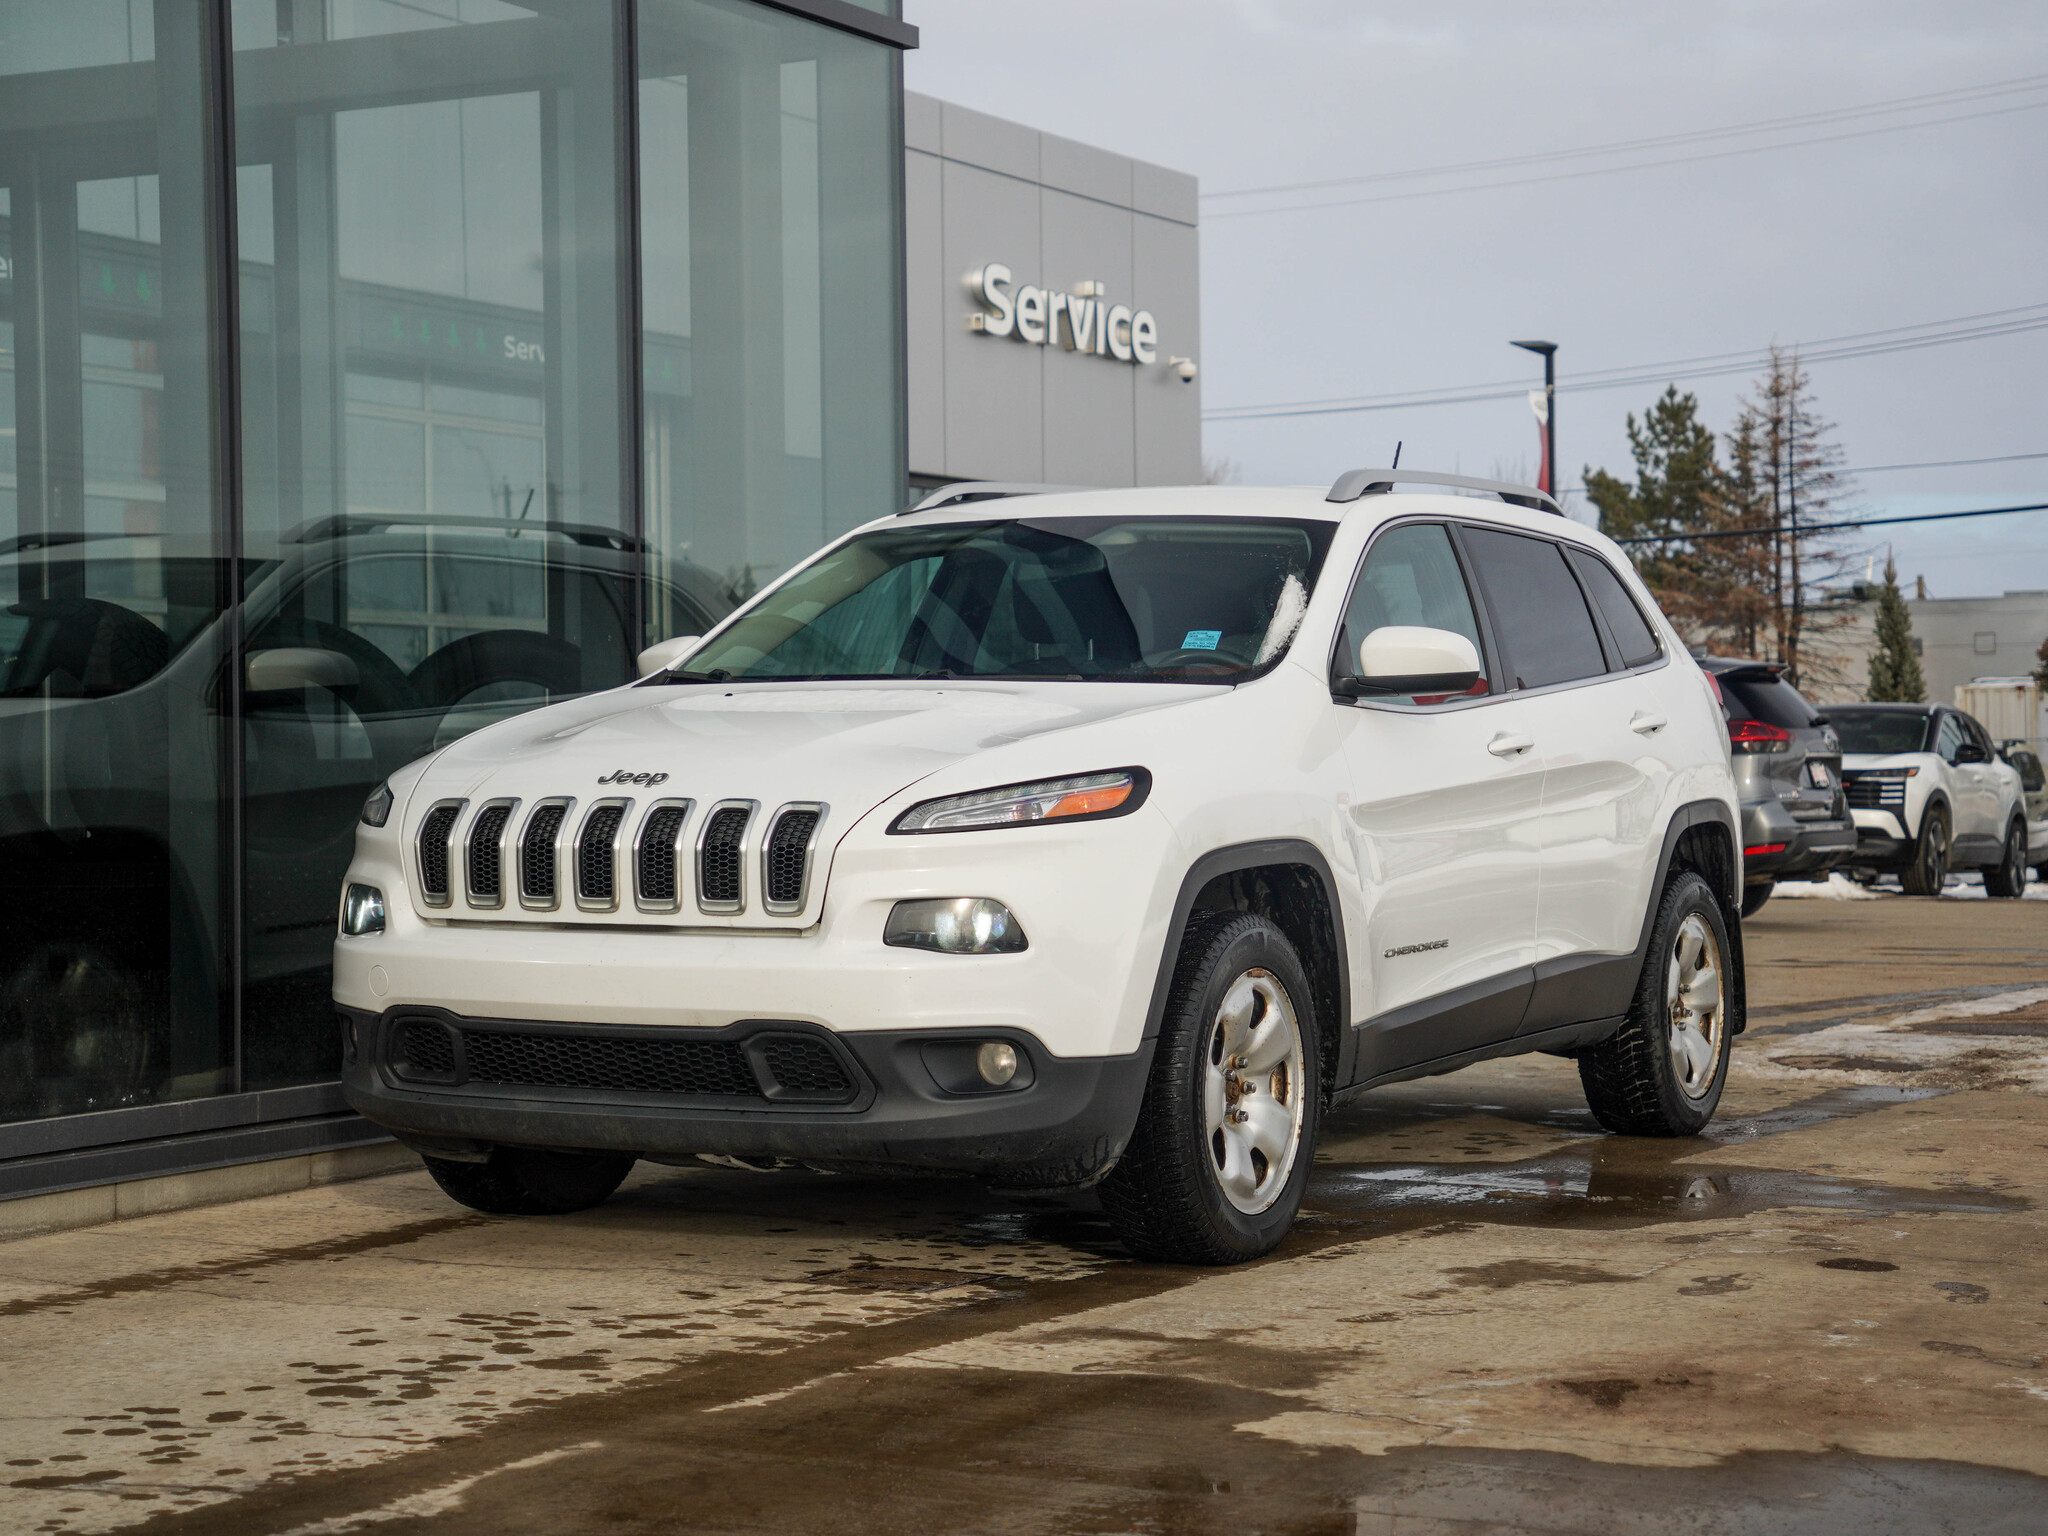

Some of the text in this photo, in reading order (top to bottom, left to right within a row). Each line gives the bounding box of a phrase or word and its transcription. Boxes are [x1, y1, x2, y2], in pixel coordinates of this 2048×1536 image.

[978, 262, 1158, 365] Service
[597, 769, 670, 788] Jeep
[1383, 939, 1449, 958] CHEROKEE
